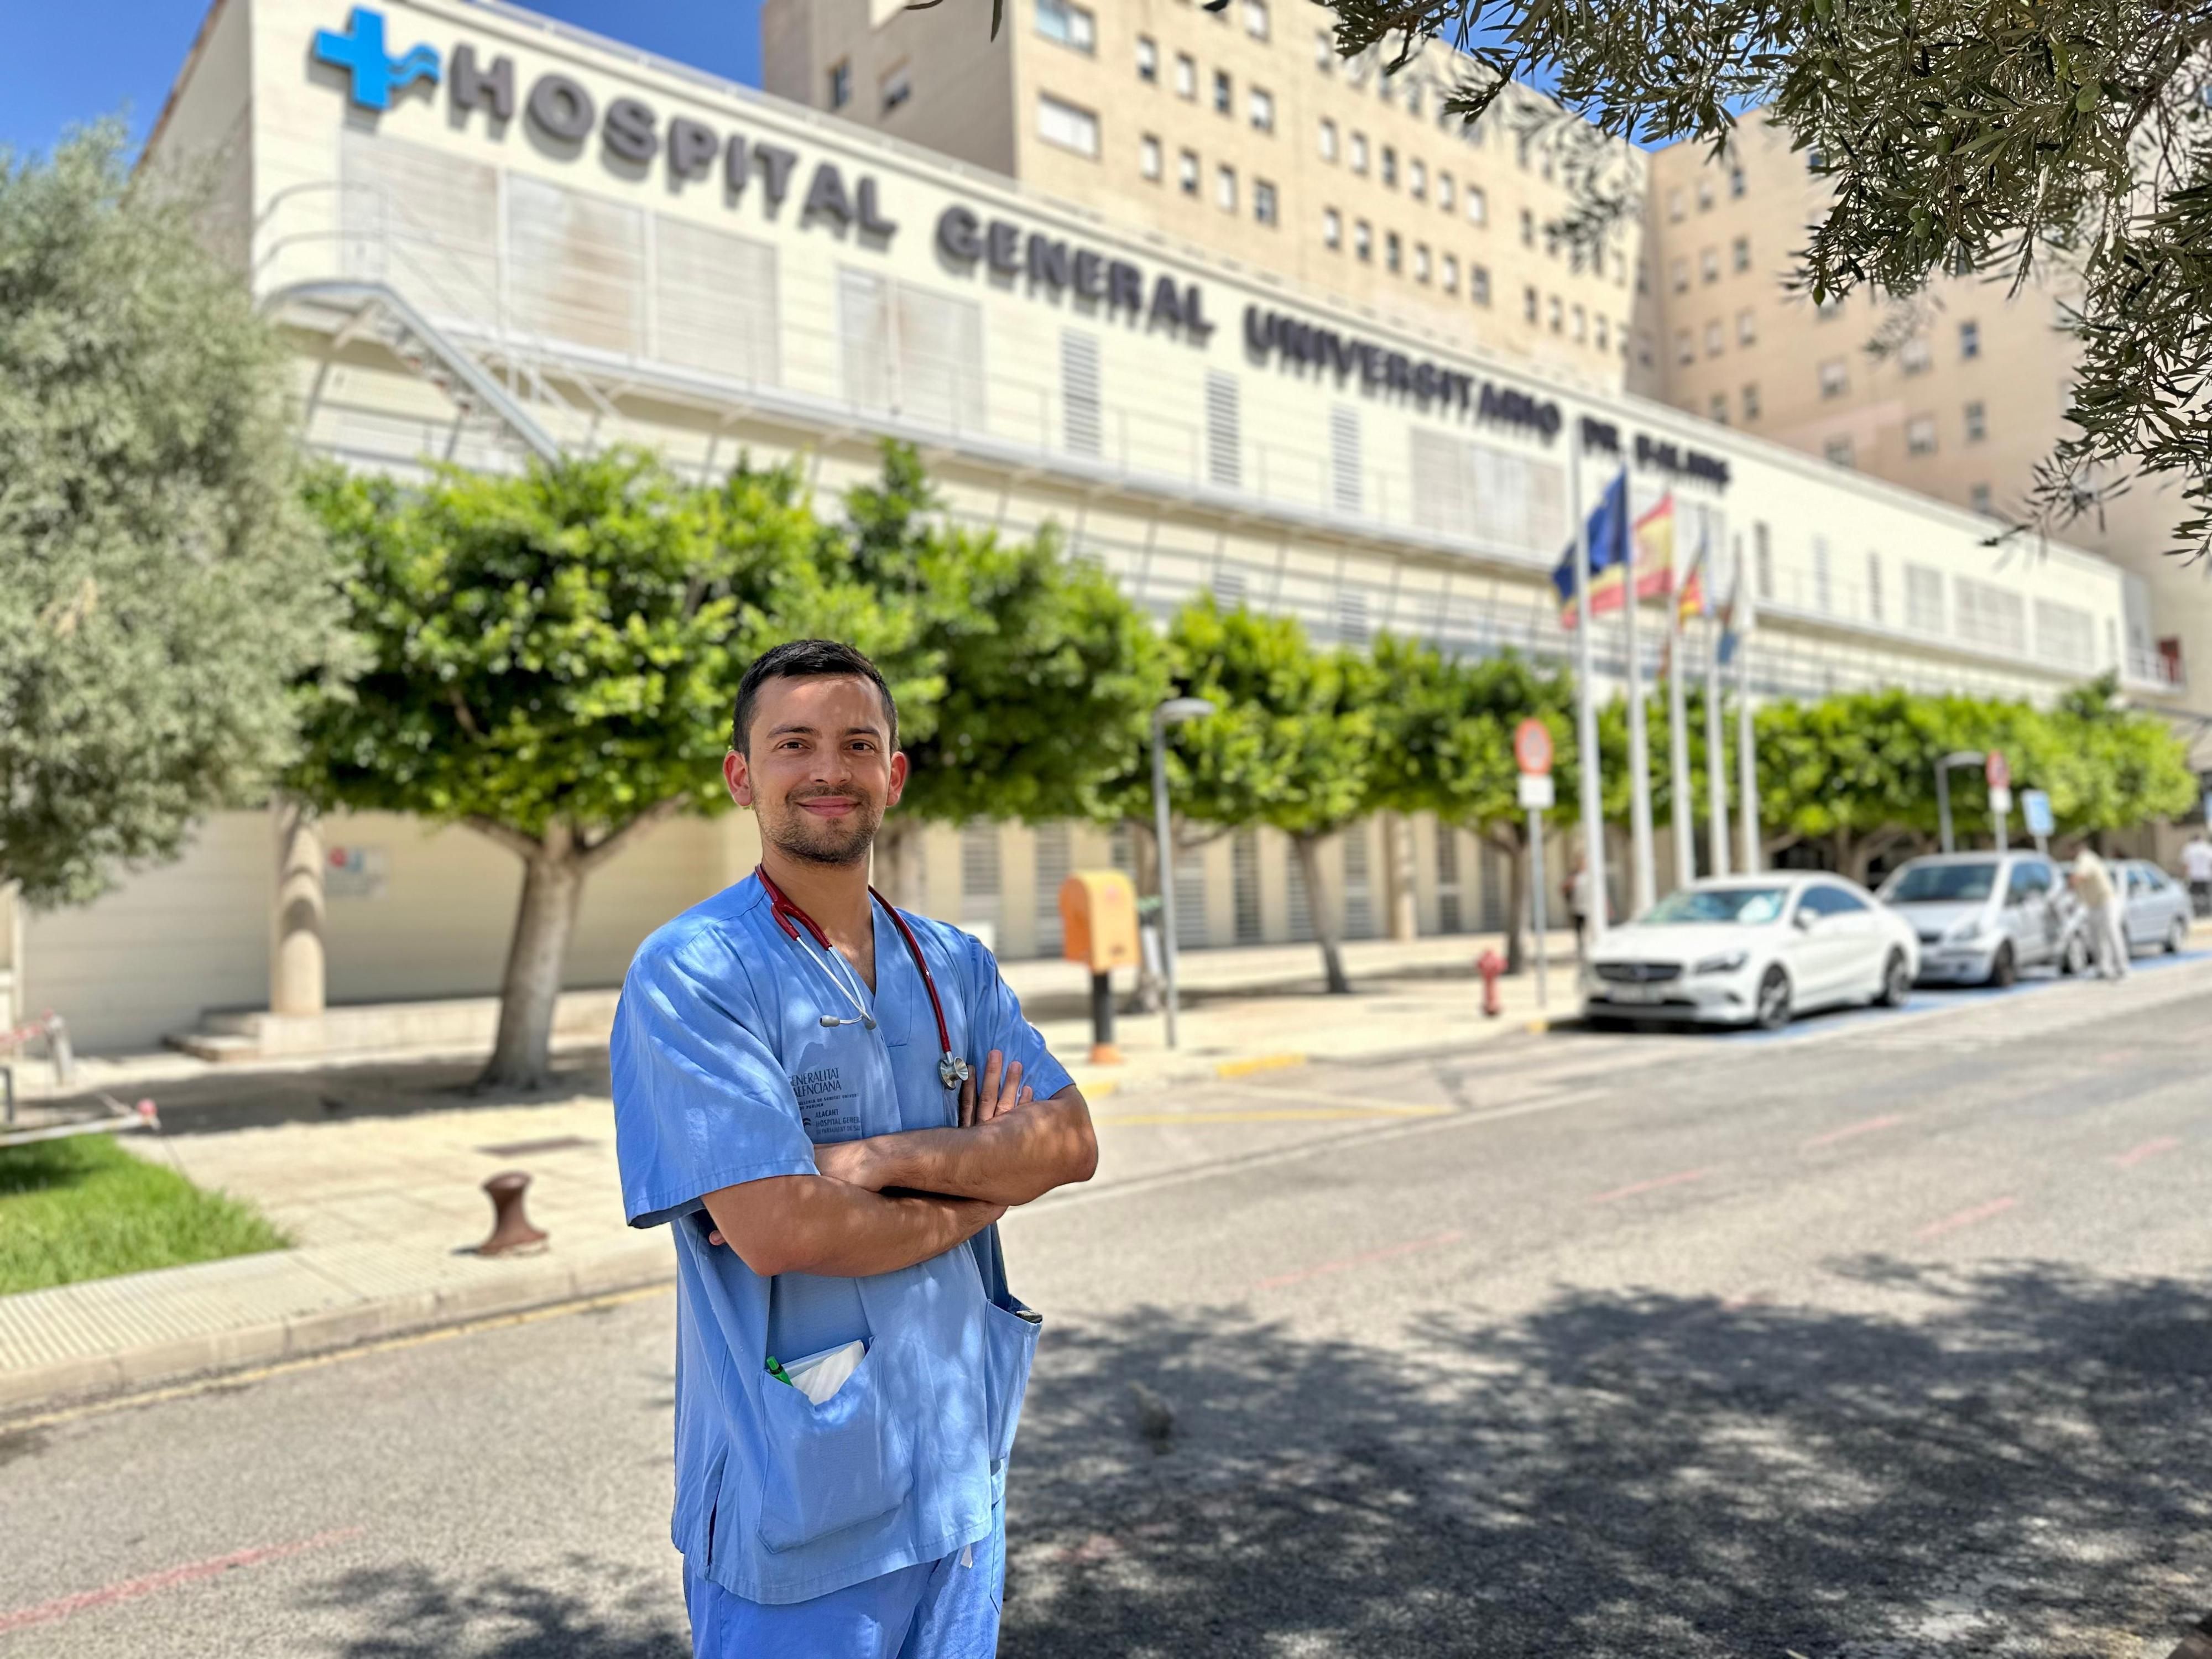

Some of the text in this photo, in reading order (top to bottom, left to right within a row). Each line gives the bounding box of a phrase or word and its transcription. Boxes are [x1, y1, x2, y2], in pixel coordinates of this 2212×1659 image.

[450, 41, 898, 236] HOSPITAL
[936, 204, 1217, 336] GENERAL
[793, 1080, 842, 1097] ALENCIANA
[816, 1118, 841, 1128] HOSPITAL
